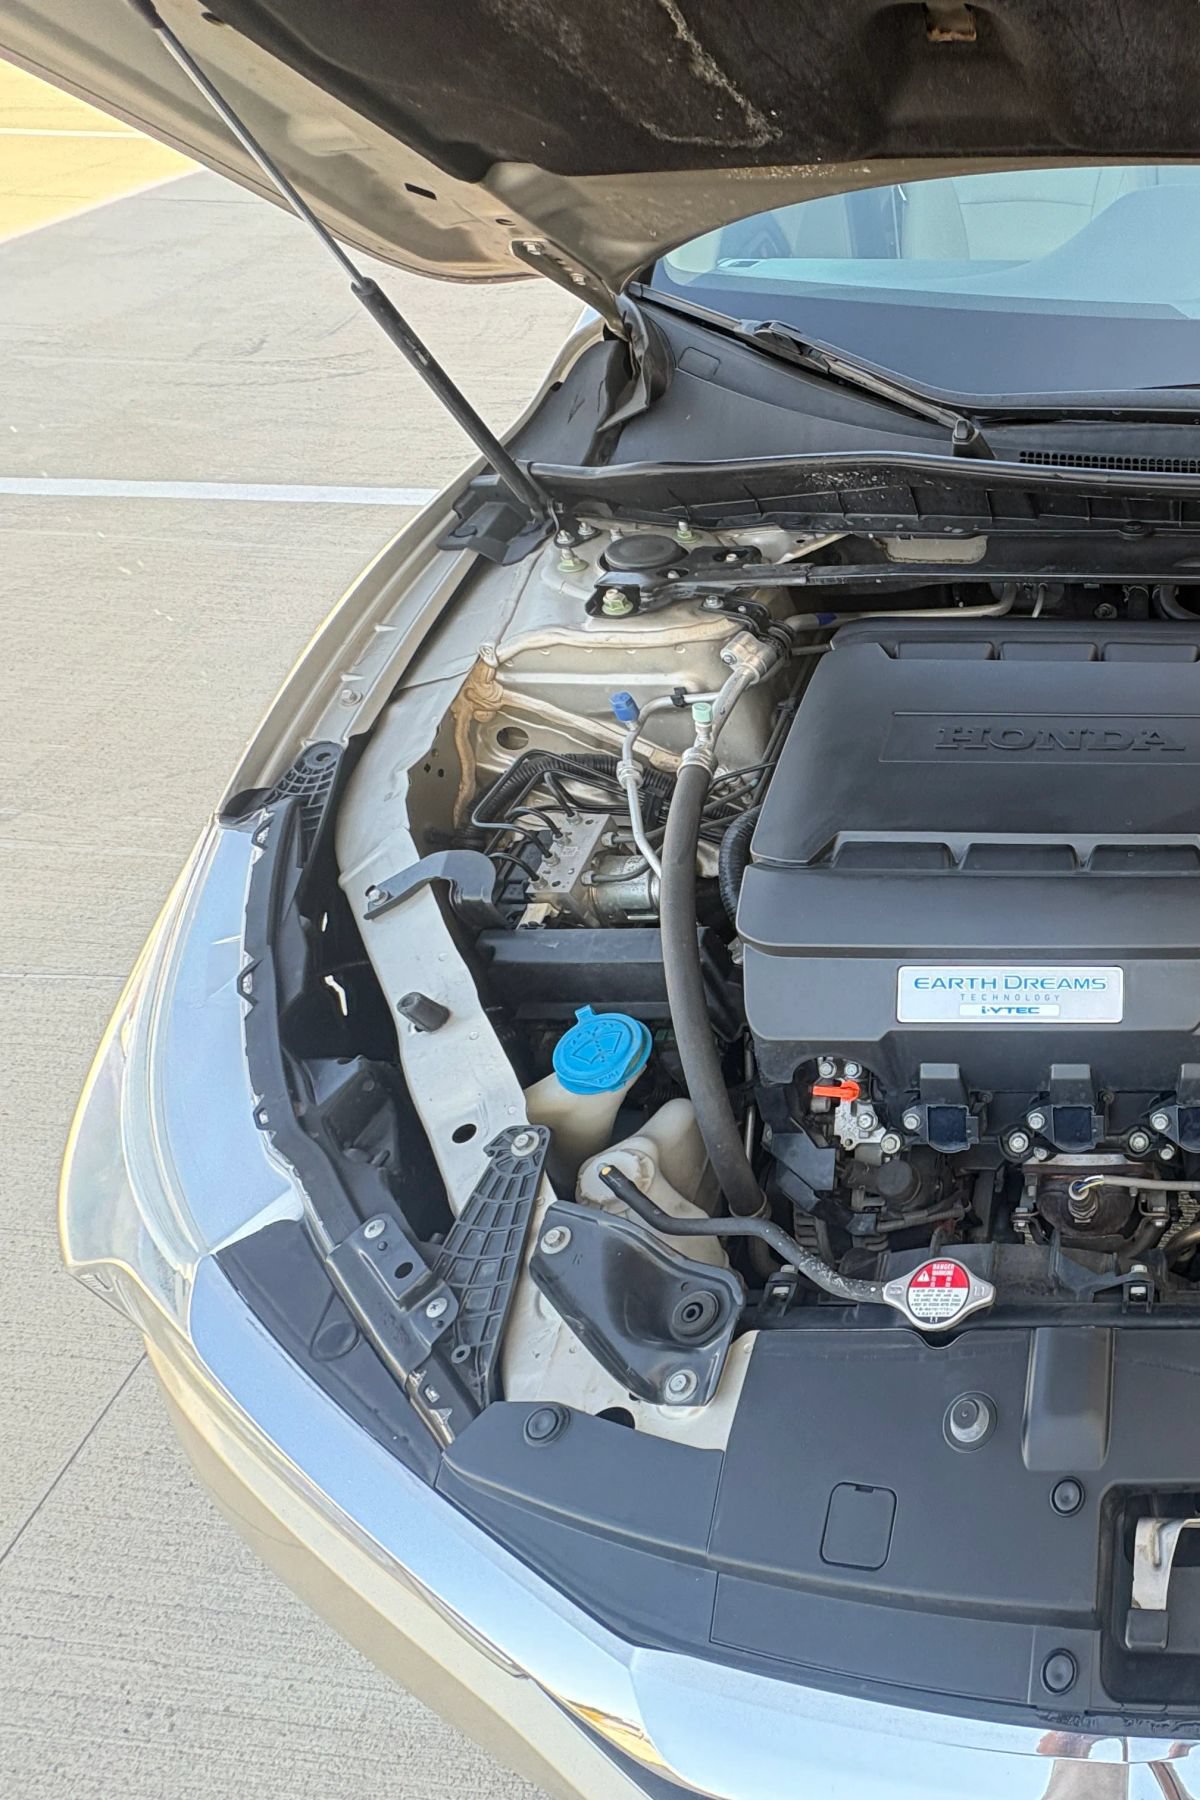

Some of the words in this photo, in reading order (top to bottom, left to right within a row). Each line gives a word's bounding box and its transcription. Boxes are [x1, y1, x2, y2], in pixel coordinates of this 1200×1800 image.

[935, 727, 1186, 752] HONDA
[913, 976, 996, 990] EARTH
[1004, 975, 1107, 990] DREAMS
[960, 993, 1061, 1002] TECHNOLOGY
